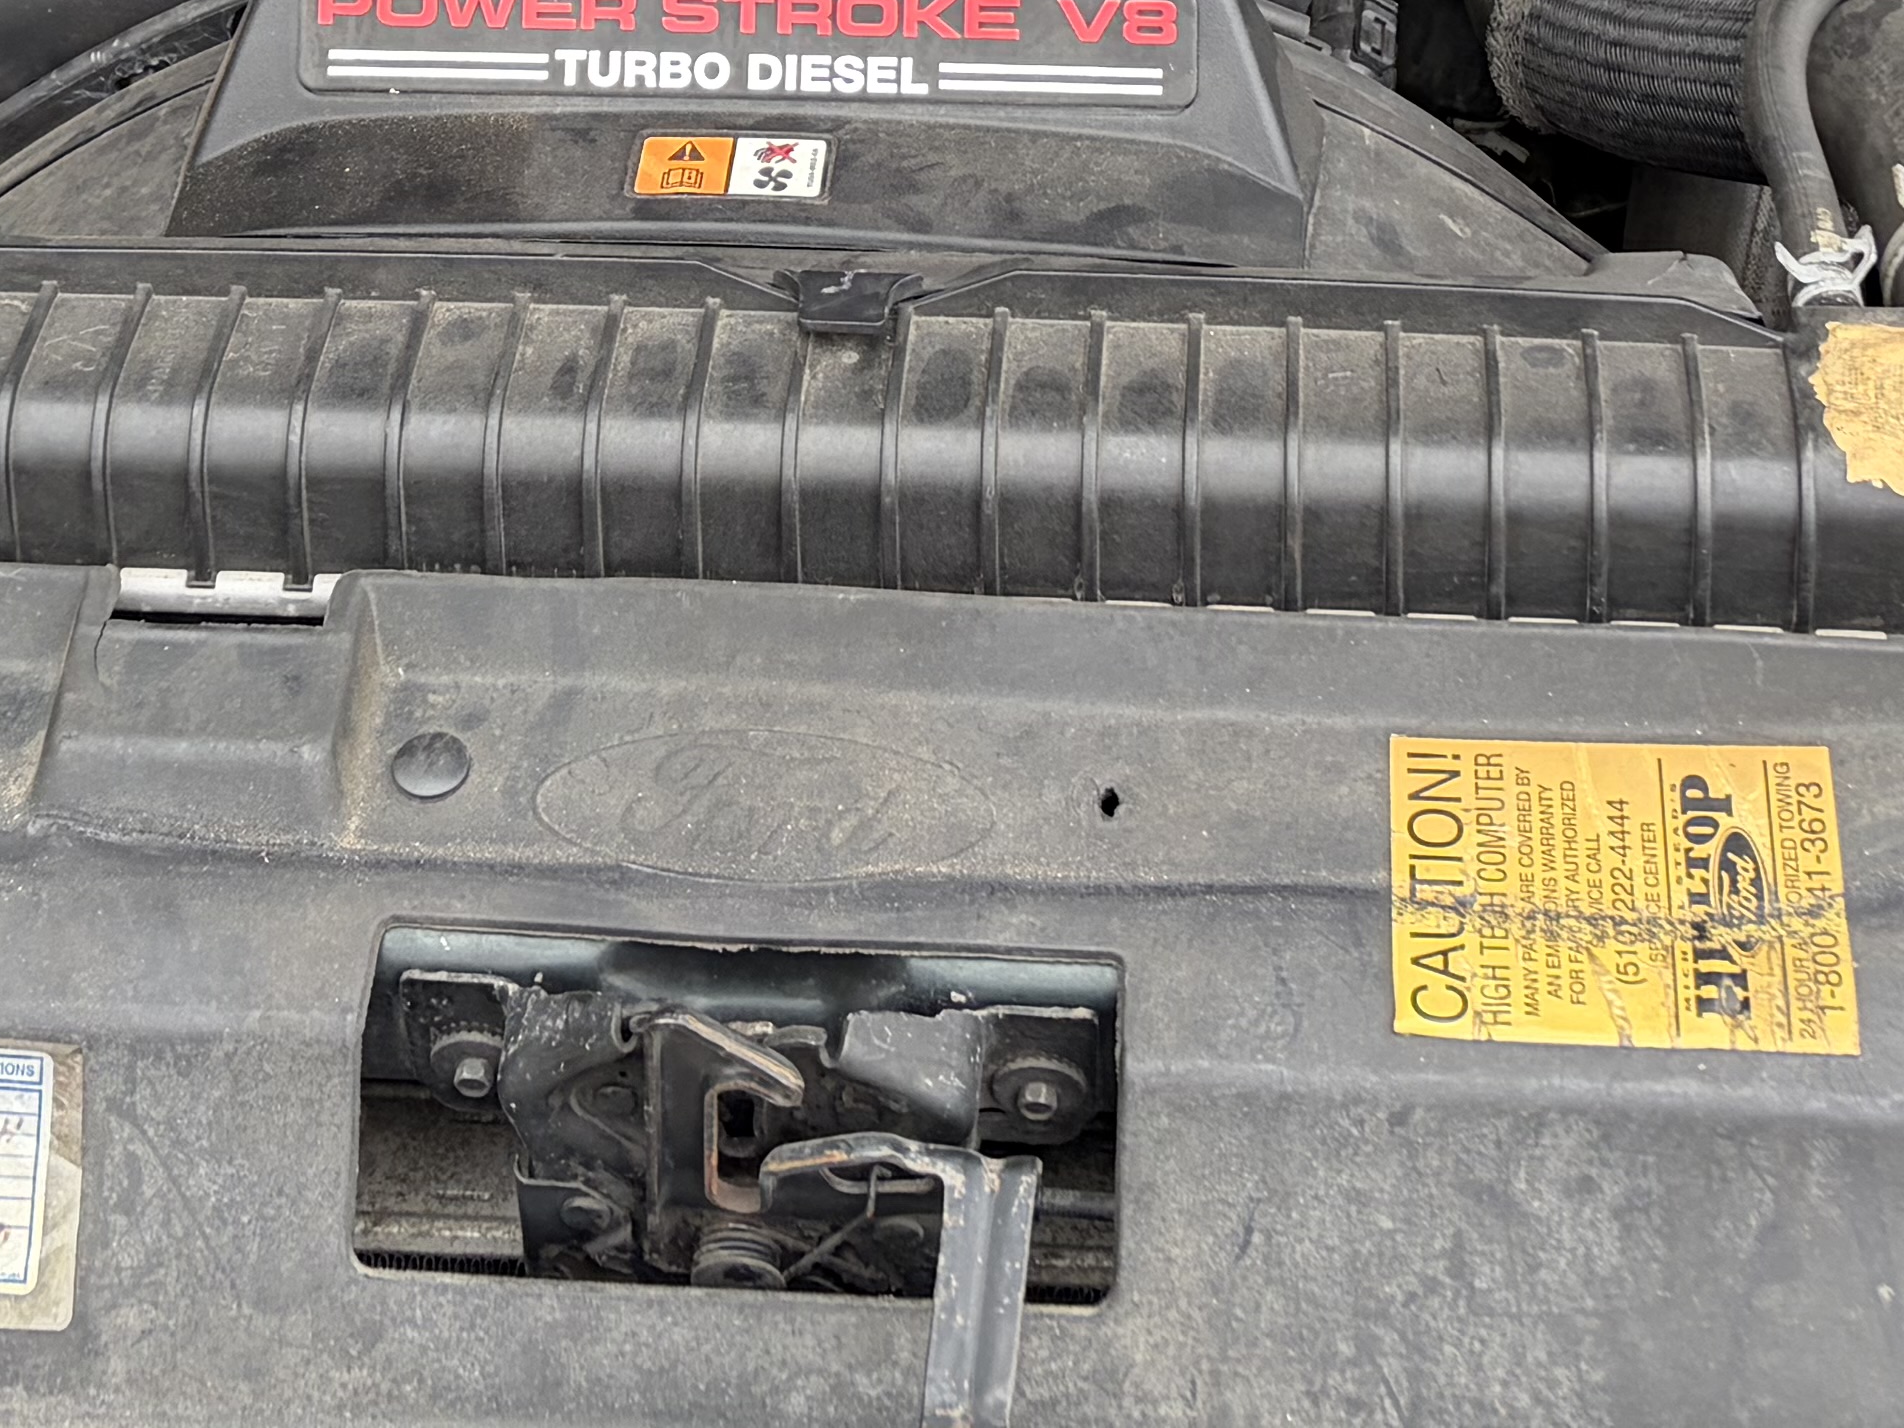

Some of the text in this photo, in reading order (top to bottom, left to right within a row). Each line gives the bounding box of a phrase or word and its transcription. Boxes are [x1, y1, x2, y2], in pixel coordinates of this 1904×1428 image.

[554, 48, 930, 96] TURBO DIESEL
[1514, 766, 1531, 791] BY
[1772, 761, 1797, 835] TOWING
[1473, 752, 1509, 883] COMPUTER
[1515, 791, 1535, 869] COVERED
[1537, 784, 1558, 873] WARRANTY
[1559, 780, 1581, 885] AUTHORIZED
[1669, 782, 1684, 886] STEAD'S
[1585, 832, 1603, 874] CALL
[1606, 797, 1638, 912] 222-4444
[1640, 821, 1660, 888] CENTER
[1518, 872, 1538, 910] ARE
[1480, 963, 1513, 1027] HIGH
[1522, 966, 1541, 1017] MANY
[1546, 975, 1564, 1001] AN
[1568, 968, 1588, 1006] FOR
[1791, 958, 1813, 1016] HOUR
